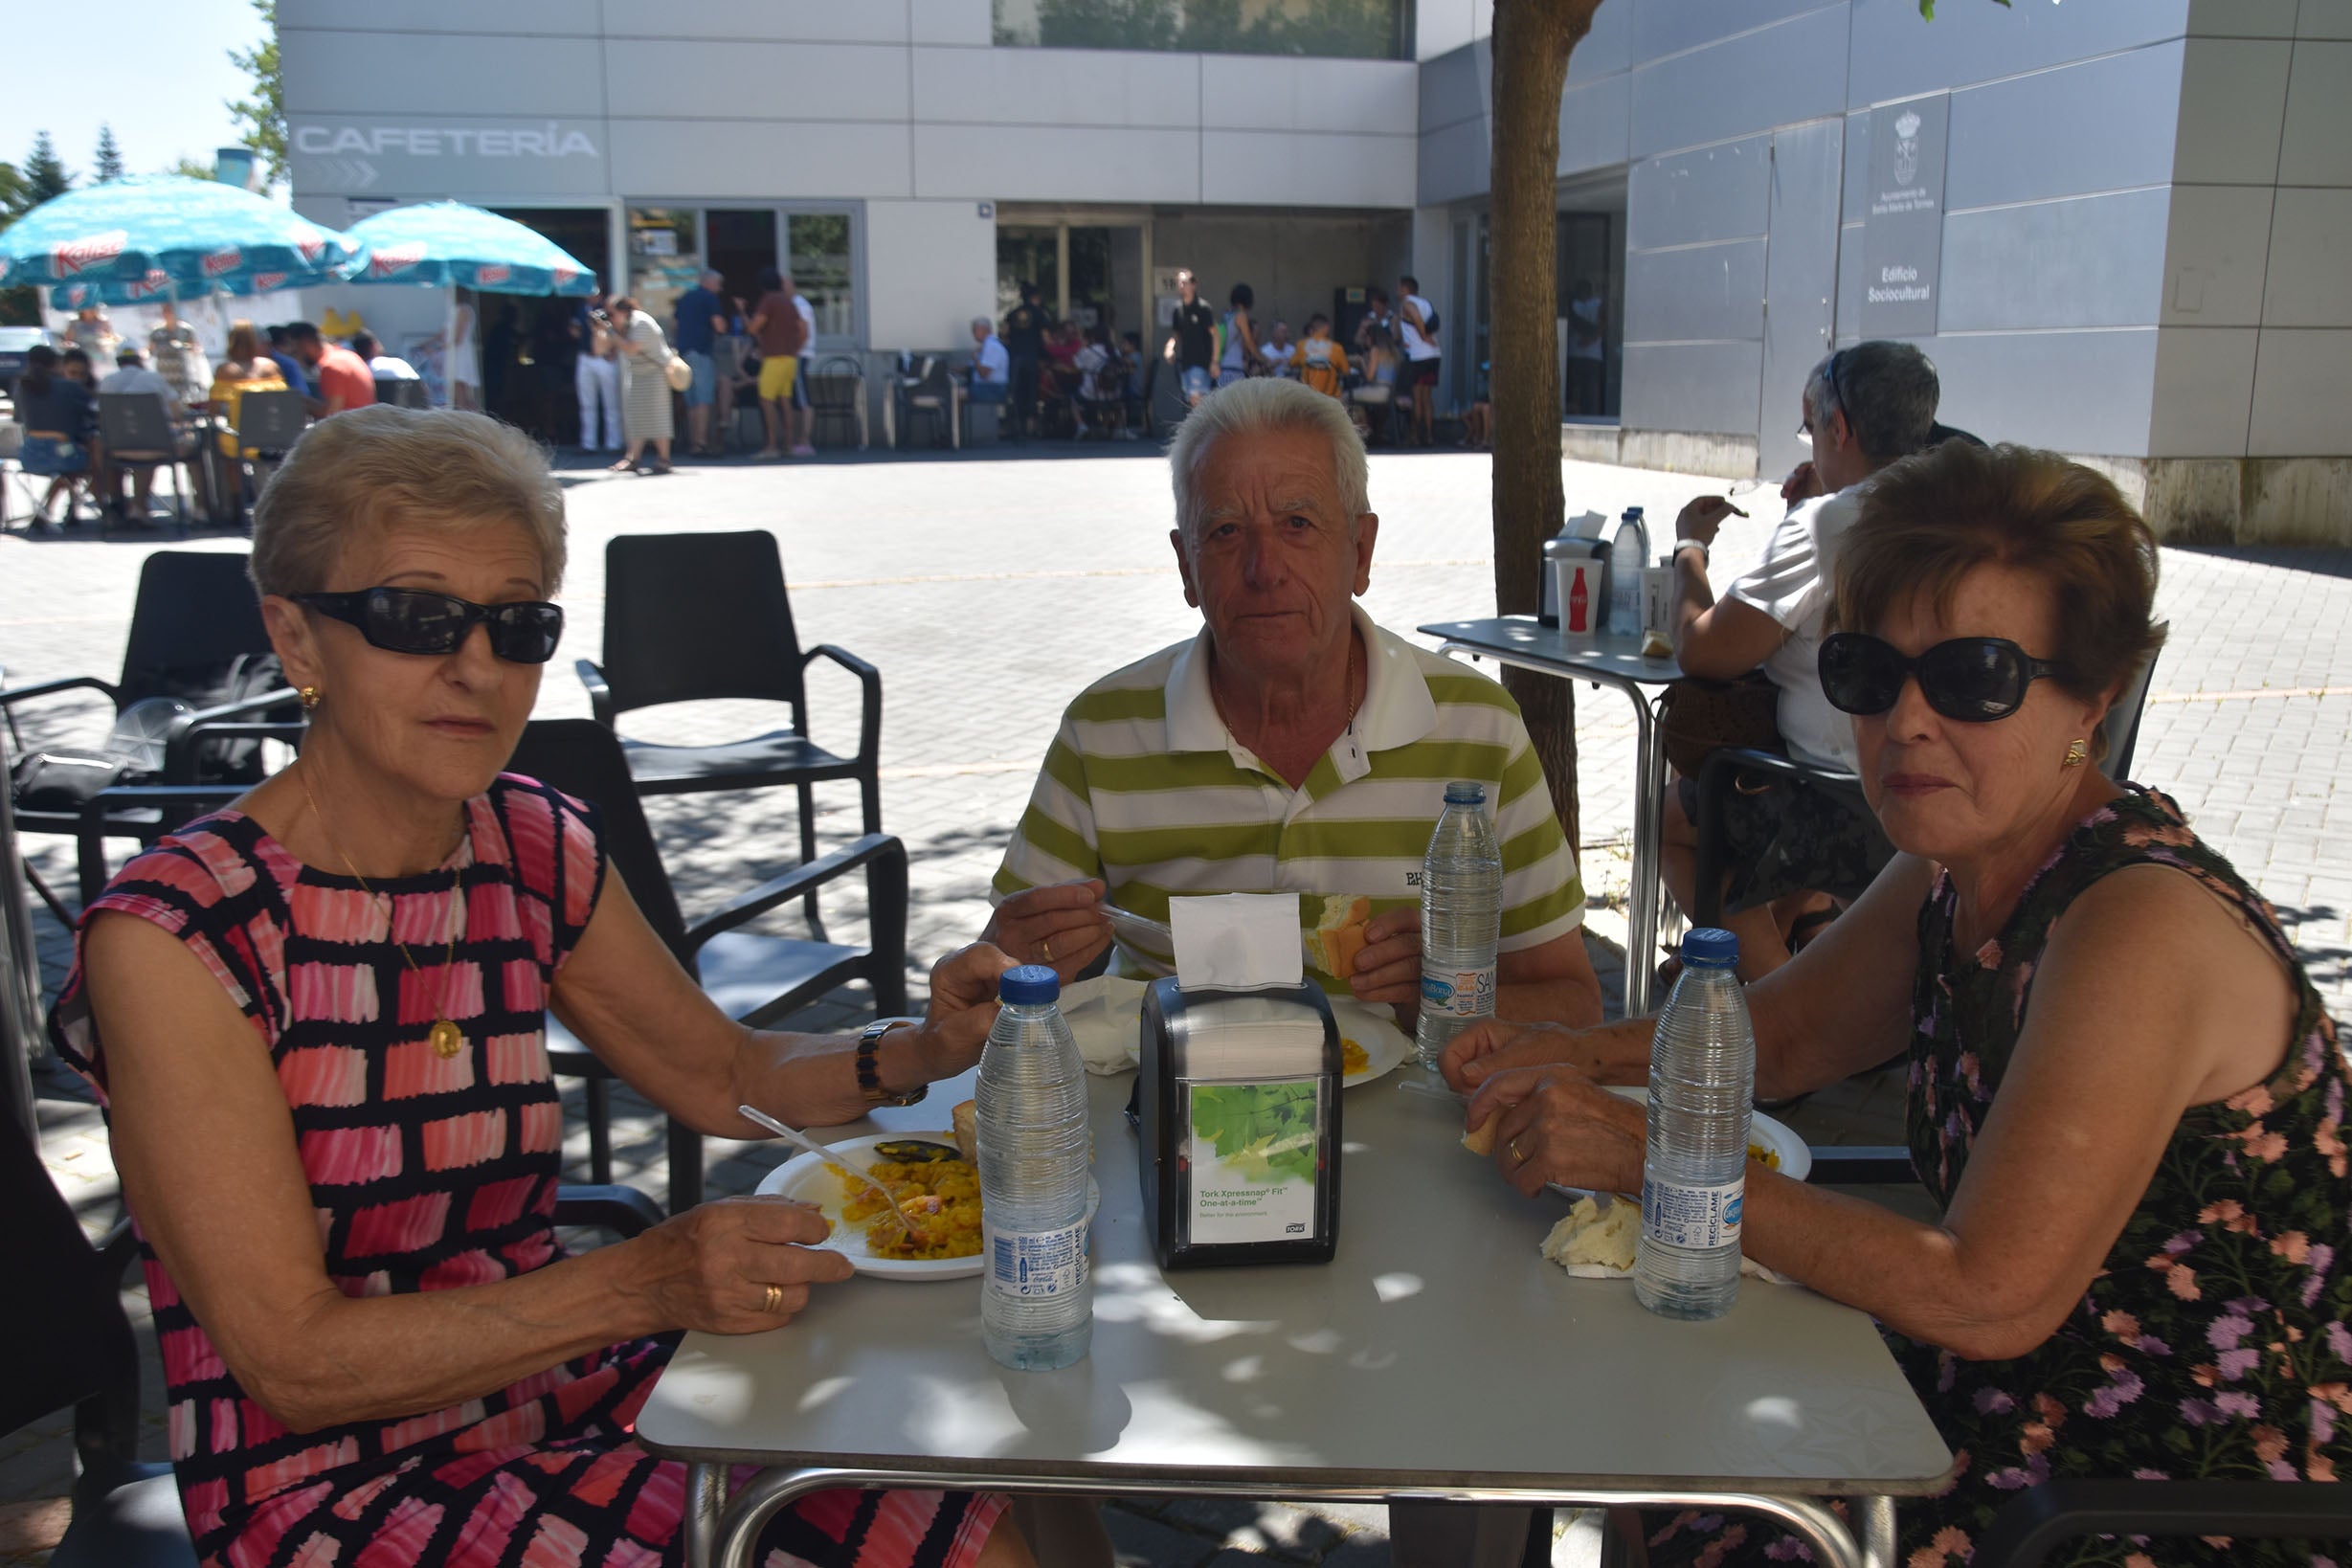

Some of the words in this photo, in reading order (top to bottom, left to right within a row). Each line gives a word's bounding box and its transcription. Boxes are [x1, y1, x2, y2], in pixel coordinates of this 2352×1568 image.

[295, 121, 599, 157] CAFETERÍA
[55, 239, 126, 279] Kalise
[1882, 265, 1917, 283] Edificio
[1868, 284, 1930, 302] Sociocultural
[1286, 1225, 1305, 1234] TORK
